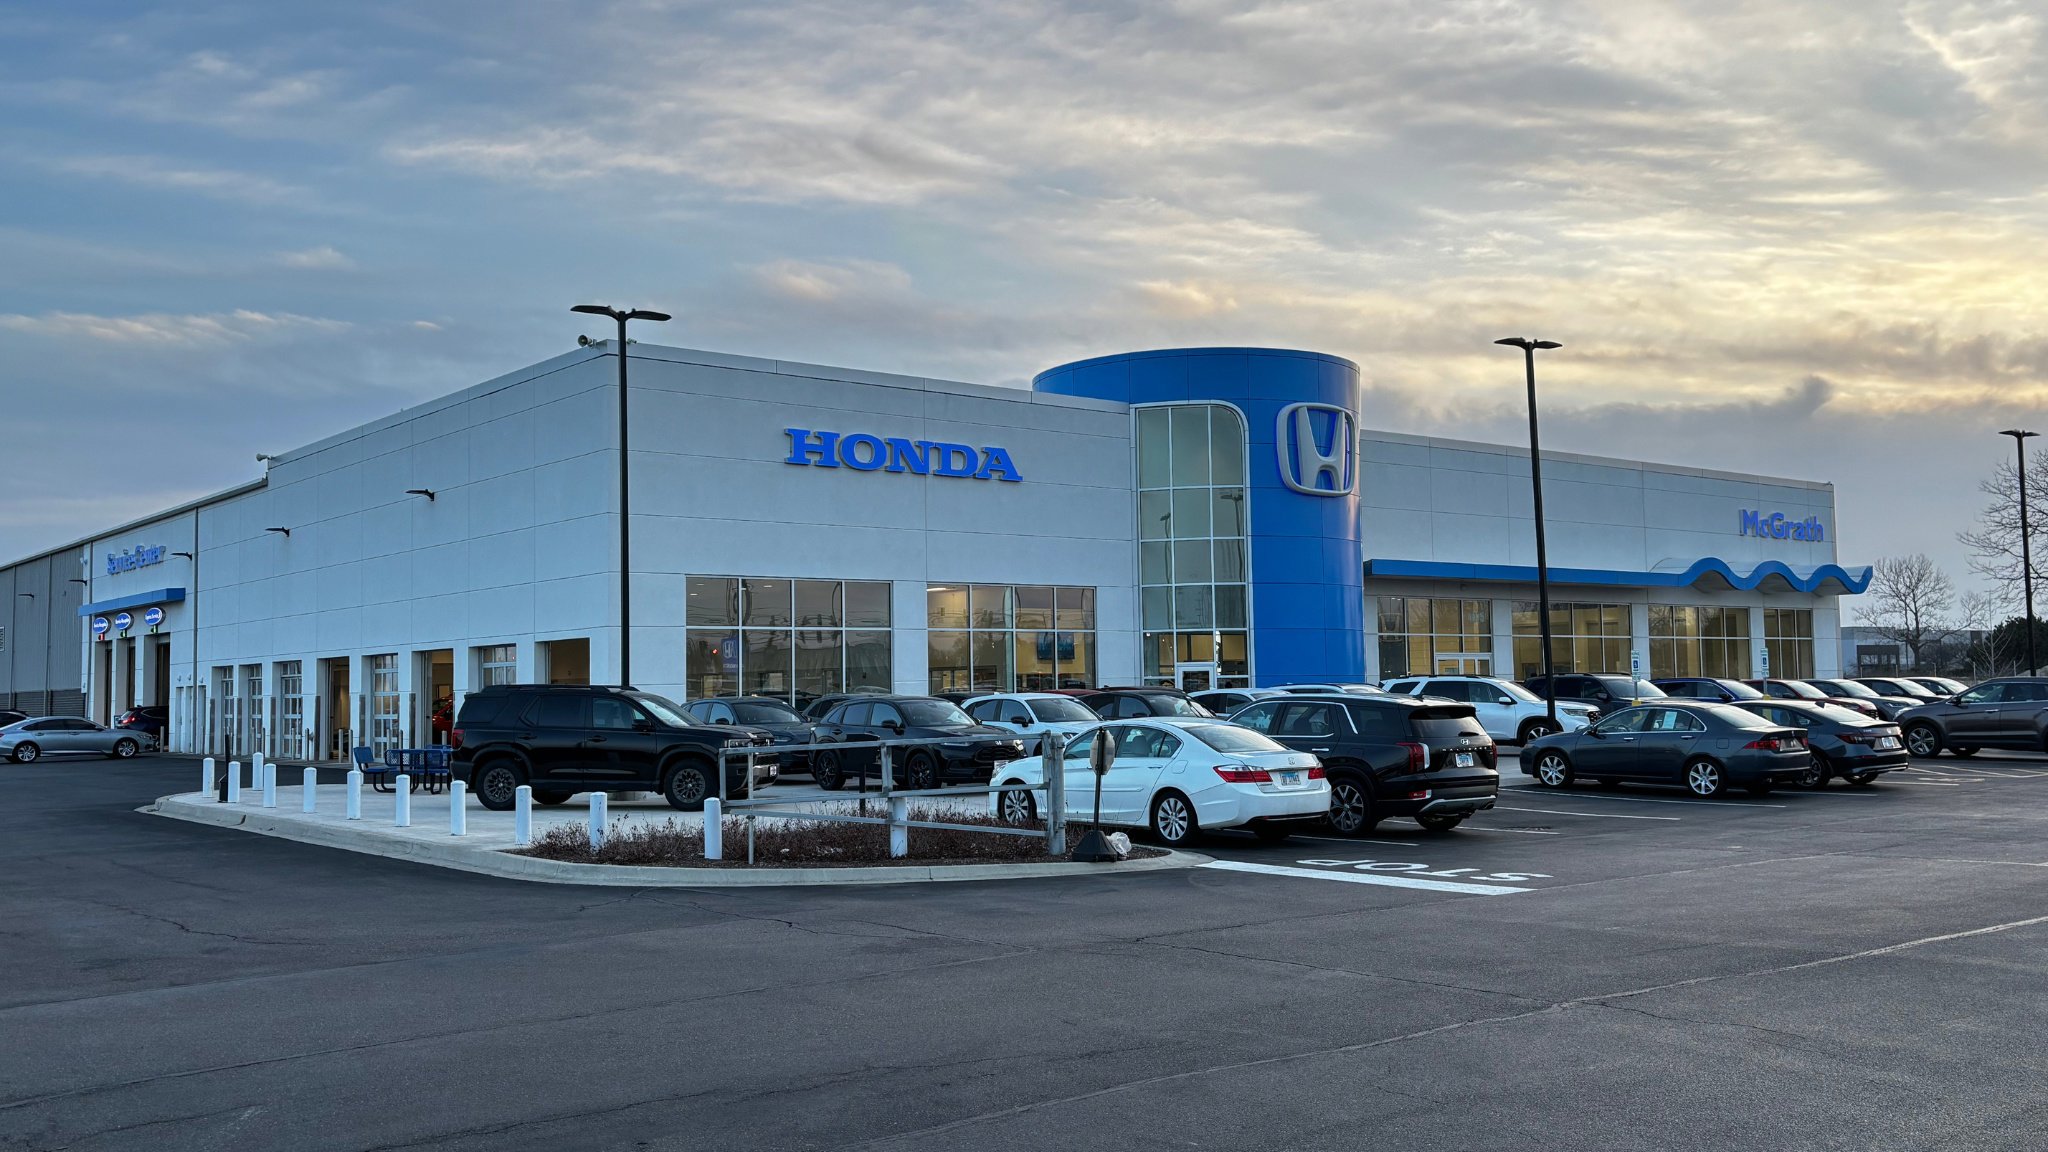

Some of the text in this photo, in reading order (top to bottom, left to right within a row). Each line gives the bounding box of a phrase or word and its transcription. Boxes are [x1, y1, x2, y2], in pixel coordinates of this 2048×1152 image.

[785, 428, 1023, 482] HONDA
[1739, 509, 1823, 542] McGrath
[1296, 859, 1554, 882] STOP
